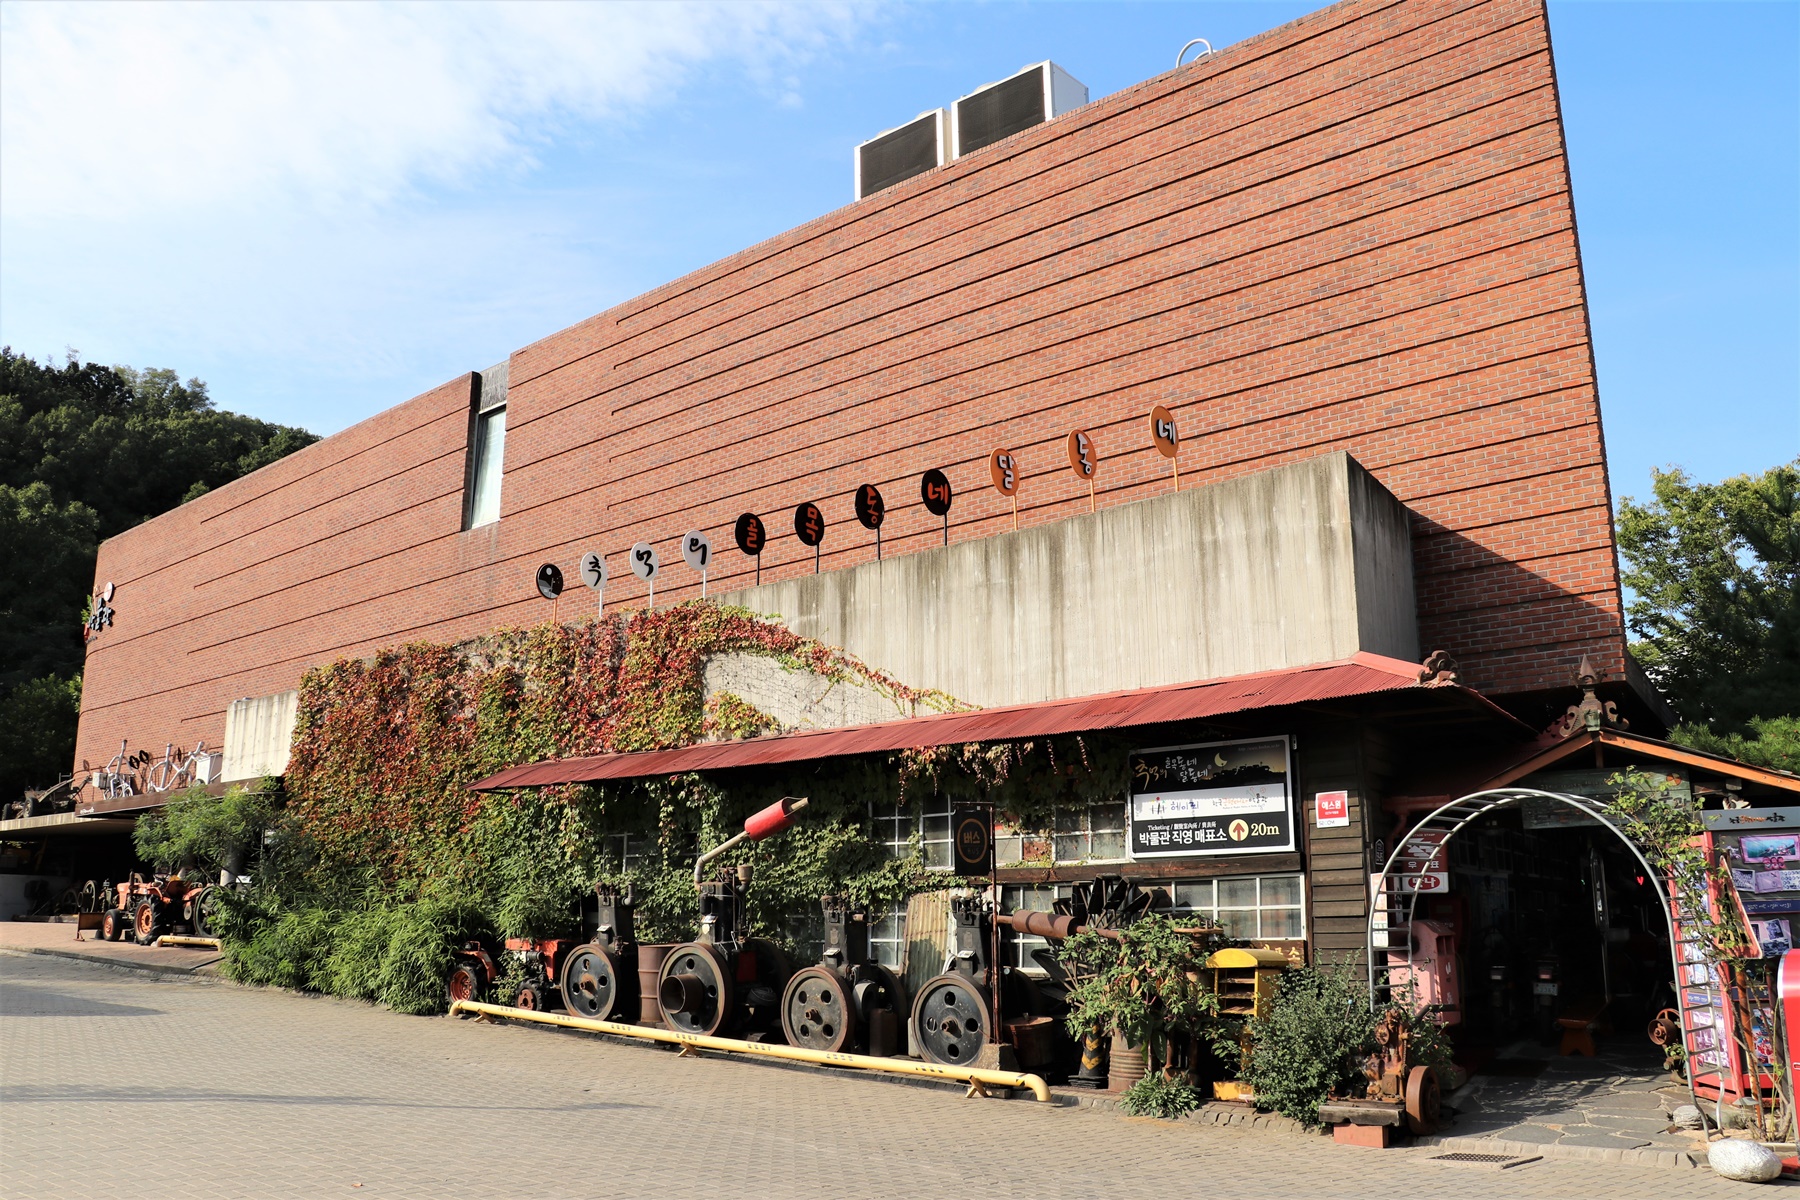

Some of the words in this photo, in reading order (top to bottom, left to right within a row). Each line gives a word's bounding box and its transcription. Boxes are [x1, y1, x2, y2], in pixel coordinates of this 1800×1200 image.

[1321, 800, 1341, 810] 에스원
[1250, 823, 1280, 836] 20m
[963, 831, 981, 844] 버스
[1139, 832, 1170, 847] 박물관
[1172, 830, 1193, 845] 직영
[1194, 828, 1228, 843] 매표소
